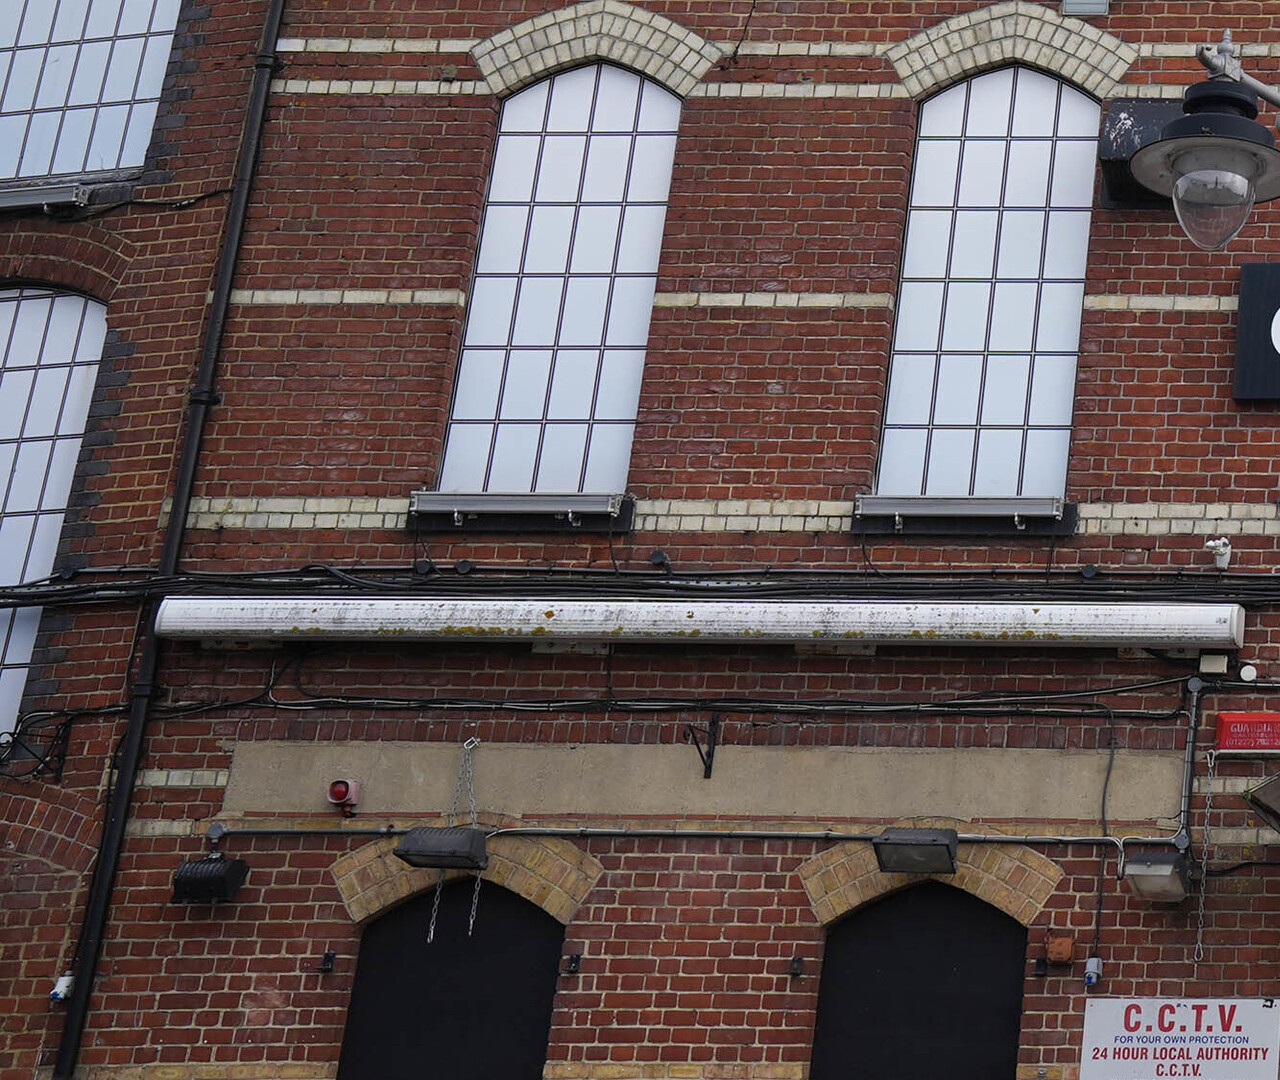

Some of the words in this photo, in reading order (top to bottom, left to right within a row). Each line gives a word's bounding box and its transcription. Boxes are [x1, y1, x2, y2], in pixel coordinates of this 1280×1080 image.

[1123, 1003, 1243, 1032] C.C.T.V.
[1114, 1036, 1134, 1044] FOR
[1136, 1036, 1161, 1044] YOUR
[1163, 1036, 1186, 1044] OWN
[1189, 1036, 1249, 1044] PROTECTION
[1092, 1047, 1108, 1060] 24
[1113, 1047, 1148, 1060] HOUR
[1153, 1047, 1192, 1060] LOCAL
[1197, 1047, 1269, 1060] AUTHORITY
[1156, 1063, 1202, 1076] C.C.T.V.
